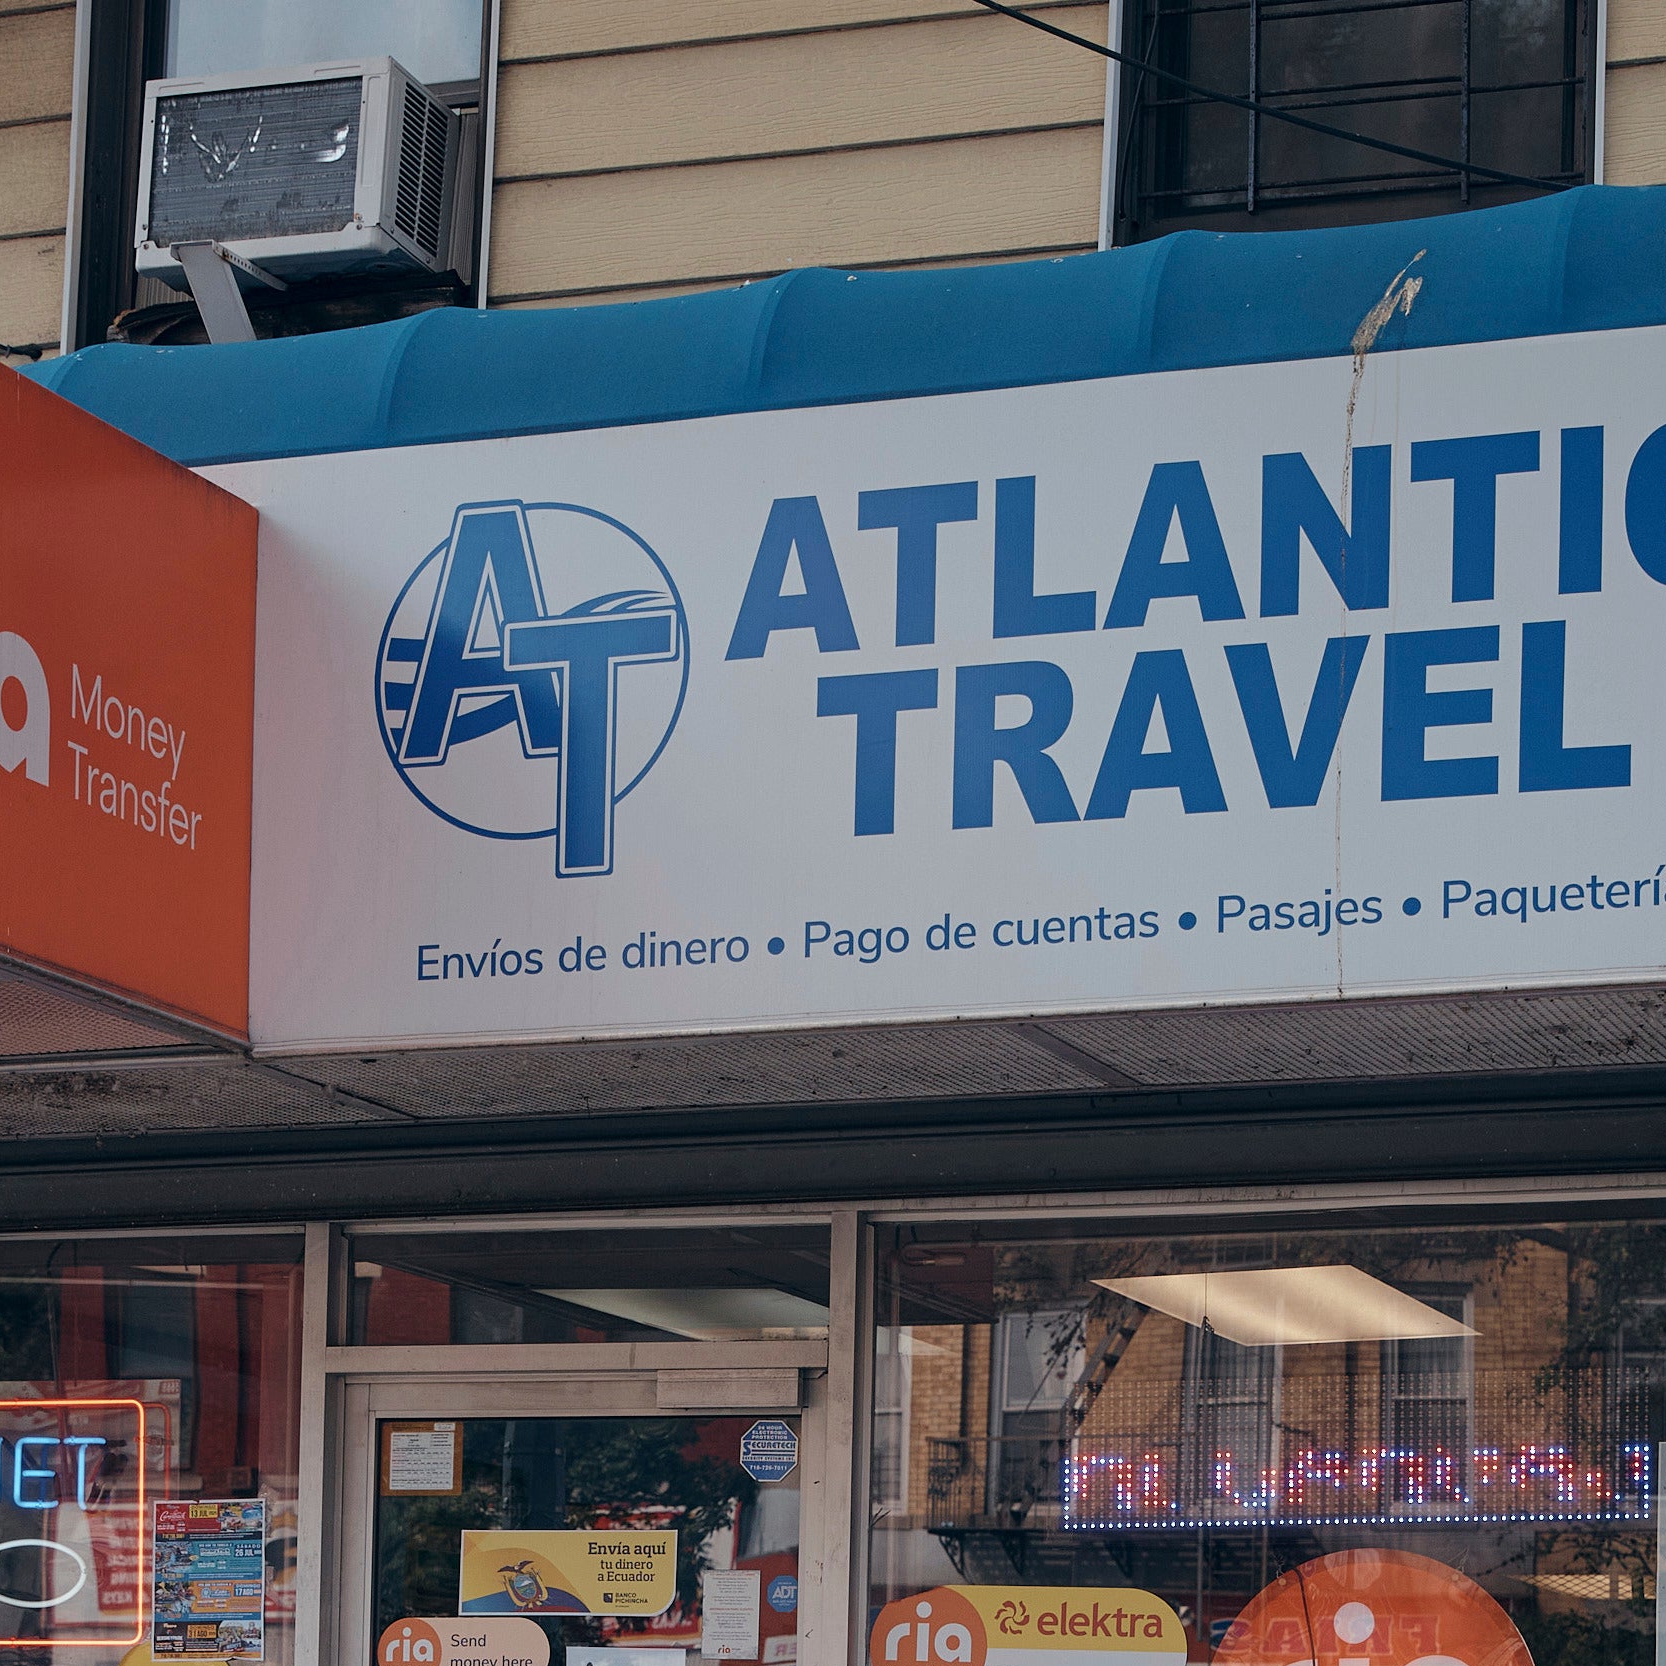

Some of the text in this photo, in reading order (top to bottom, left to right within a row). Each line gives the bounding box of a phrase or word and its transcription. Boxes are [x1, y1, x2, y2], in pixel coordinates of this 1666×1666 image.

[71, 663, 185, 781] Money
[817, 620, 1633, 836] TRAVEL
[67, 742, 203, 850] Transfer
[415, 935, 545, 981] Envíos
[558, 929, 609, 974] de
[622, 926, 749, 971] dinero
[803, 918, 912, 968] Pago
[925, 910, 977, 956] de
[992, 902, 1159, 948] cuentas
[1217, 888, 1384, 944] Pasajes
[386, 1627, 433, 1662] ria
[450, 1634, 487, 1648] Send
